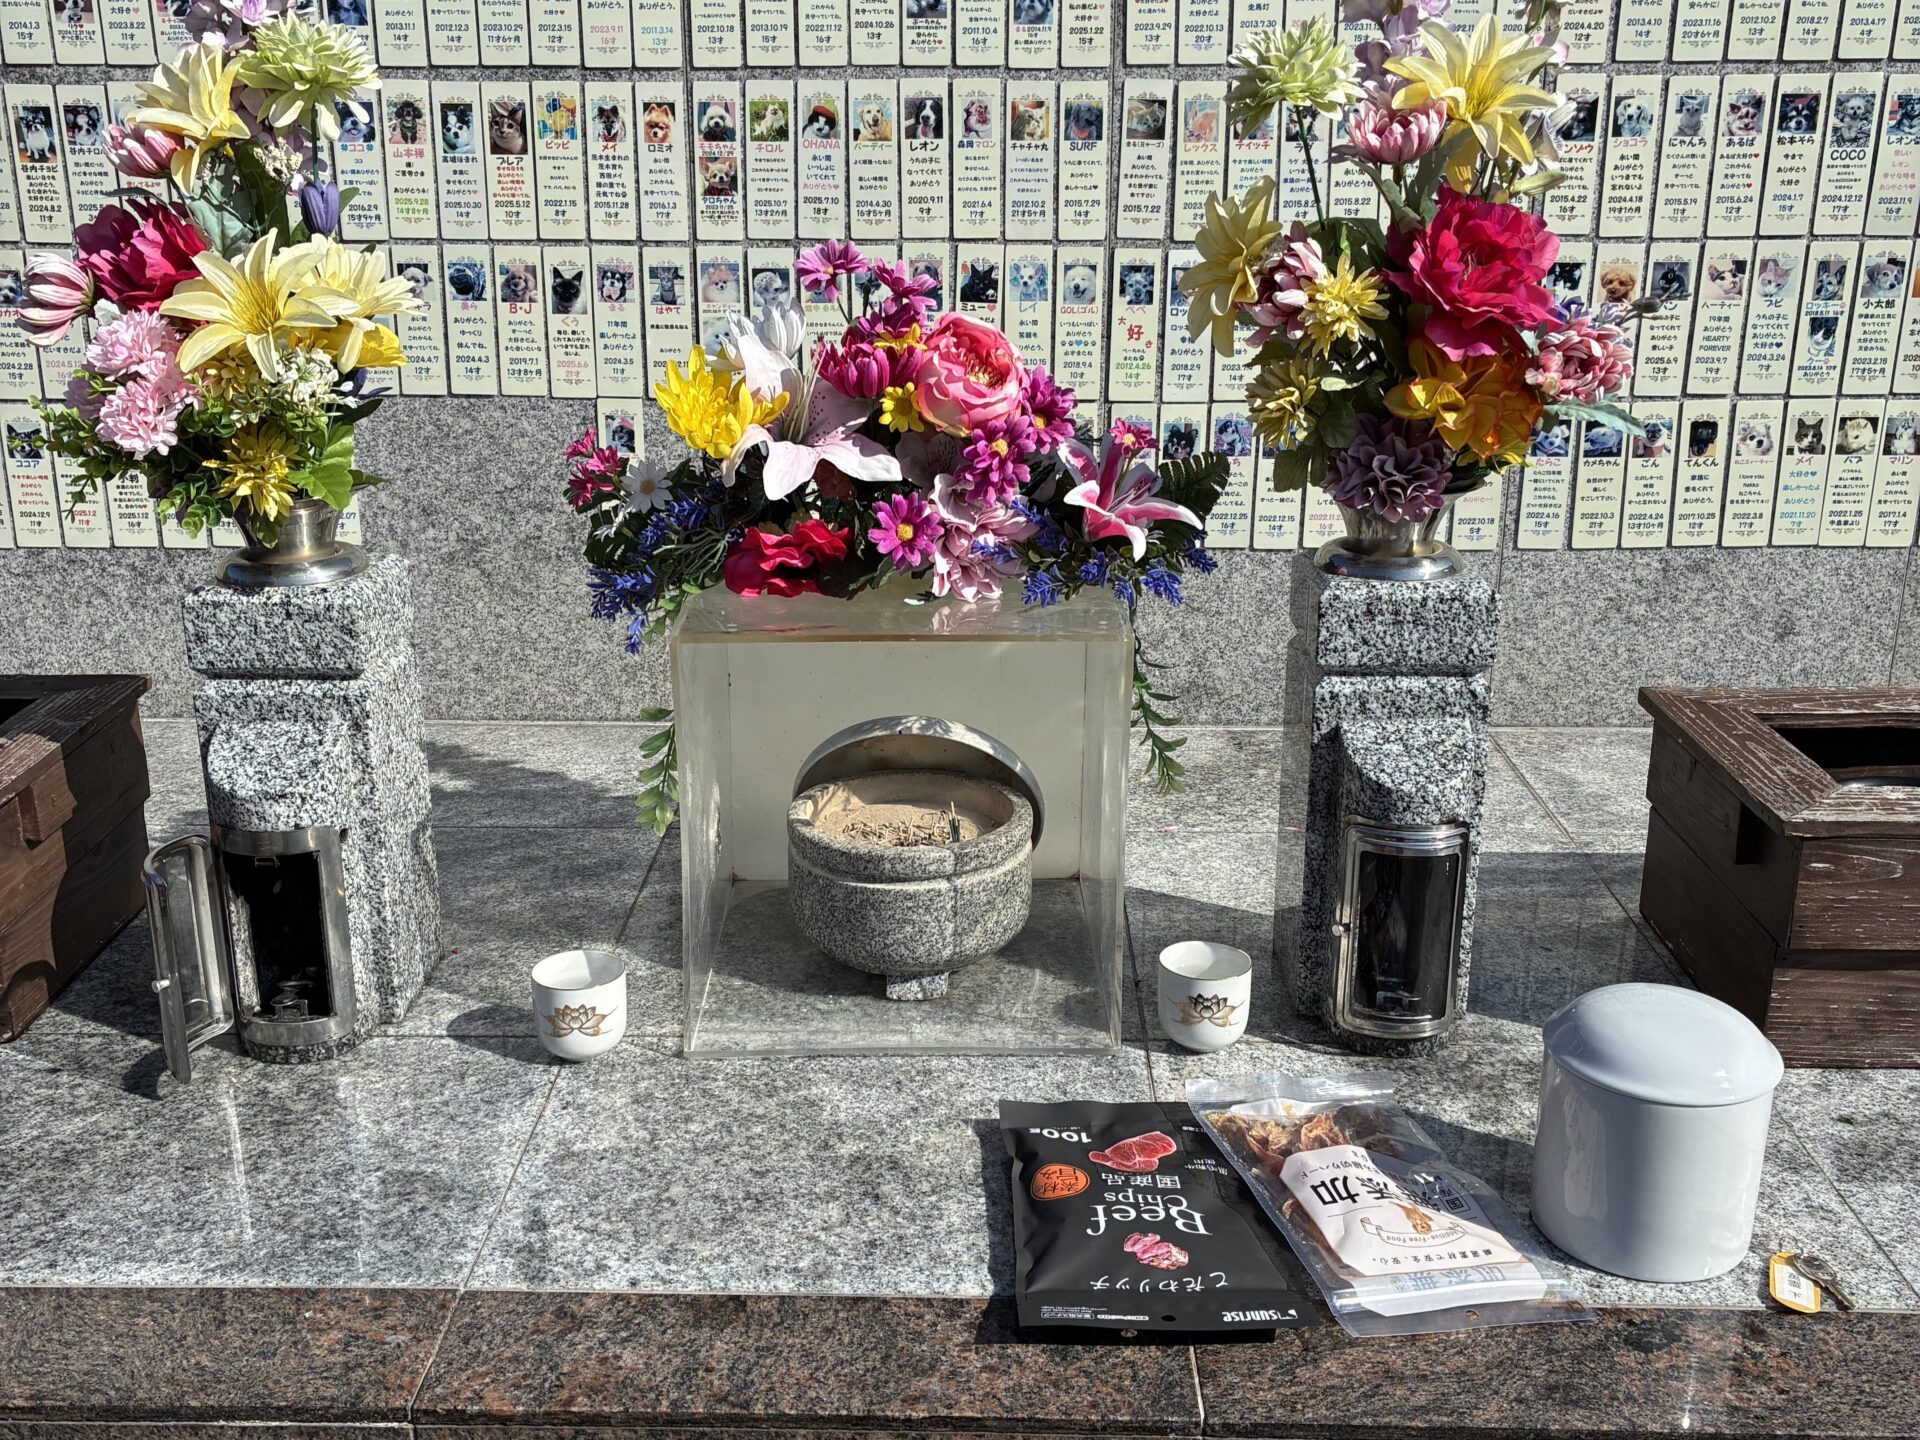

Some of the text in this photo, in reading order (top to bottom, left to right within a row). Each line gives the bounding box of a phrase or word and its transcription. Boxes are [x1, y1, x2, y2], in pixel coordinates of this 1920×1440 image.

[1240, 19, 1277, 28] 2013.7.30
[1796, 16, 1829, 24] 2018.2.7
[1849, 18, 1886, 26] 2013.4.17
[385, 22, 415, 31] 2013.11.1
[435, 23, 469, 32] 2012.12.3
[483, 23, 523, 32] 2023.10.29
[697, 25, 734, 33] 2012.10.18
[750, 24, 788, 32] 2013.10.19
[805, 24, 842, 32] 2022.11.12
[1134, 22, 1172, 31] 2023.9.29
[962, 27, 998, 35] 2011.10.4
[1069, 27, 1104, 35] 2025.1.22
[1802, 27, 1819, 36] 14才
[17, 31, 34, 40] 15才
[446, 35, 462, 43] 14才
[867, 32, 882, 40] 13才
[1145, 34, 1161, 43] 13才
[1195, 34, 1213, 43] 20才
[708, 36, 724, 45] 13才
[972, 37, 988, 46] 16才
[802, 139, 841, 150] OHANA
[1776, 135, 1815, 146] 松本そら
[1069, 141, 1097, 151] SURF
[1830, 149, 1866, 161] COCO
[803, 196, 840, 205] 2025.7.10
[908, 196, 943, 204] 2020.9.11
[1550, 195, 1588, 203] 2015.4.22
[1608, 195, 1643, 203] 2024.4.18
[1664, 198, 1698, 206] 2015.5.19
[1821, 194, 1863, 203] 2024.12.12
[495, 200, 531, 208] 2025.5.12
[544, 199, 577, 207] 2022.1.15
[594, 201, 629, 209] 2015.11.28
[754, 199, 788, 207] 2025.10.7
[855, 200, 892, 208] 2014.4.30
[962, 200, 992, 208] 2021.6.4
[1011, 200, 1046, 208] 2012.10.2
[29, 204, 62, 213] 2024.8.2
[813, 207, 829, 216] 18才
[919, 206, 932, 215] 9才
[1559, 205, 1576, 214] 16才
[1673, 207, 1687, 216] 11才
[1832, 204, 1849, 213] 17才
[1885, 207, 1902, 215] 16才
[456, 211, 471, 219] 14才
[604, 211, 620, 219] 16才
[656, 211, 671, 219] 17才
[969, 210, 985, 218] 17才
[1862, 298, 1896, 309] 小太郎
[509, 357, 538, 365] 2019.7.1
[604, 357, 634, 365] 2024.3.5
[1645, 357, 1678, 365] 2025.6.9
[1695, 356, 1728, 364] 2023.9.7
[1746, 353, 1786, 361] 2024.3.24
[1852, 357, 1888, 365] 2023.2.15
[1063, 361, 1093, 369] 2018.9.4
[1115, 362, 1152, 370] 2012.4.26
[1171, 363, 1201, 371] 2018.2.9
[1758, 363, 1772, 372] 7才
[414, 366, 431, 375] 12才
[613, 367, 626, 375] 11才
[1678, 512, 1716, 521] 2017.10.25
[1732, 512, 1764, 520] 2022.3.8
[1457, 517, 1495, 525] 2022.10.18
[1589, 521, 1604, 529] 21才
[1739, 521, 1754, 529] 17才
[1790, 520, 1803, 528] 7才
[1884, 519, 1899, 528] 17才
[1101, 1172, 1180, 1189] 国産品
[1104, 1188, 1187, 1211] Chips
[1086, 1205, 1213, 1236] Beef
[1386, 1235, 1407, 1243] Food
[1222, 1310, 1278, 1322] sunrise
